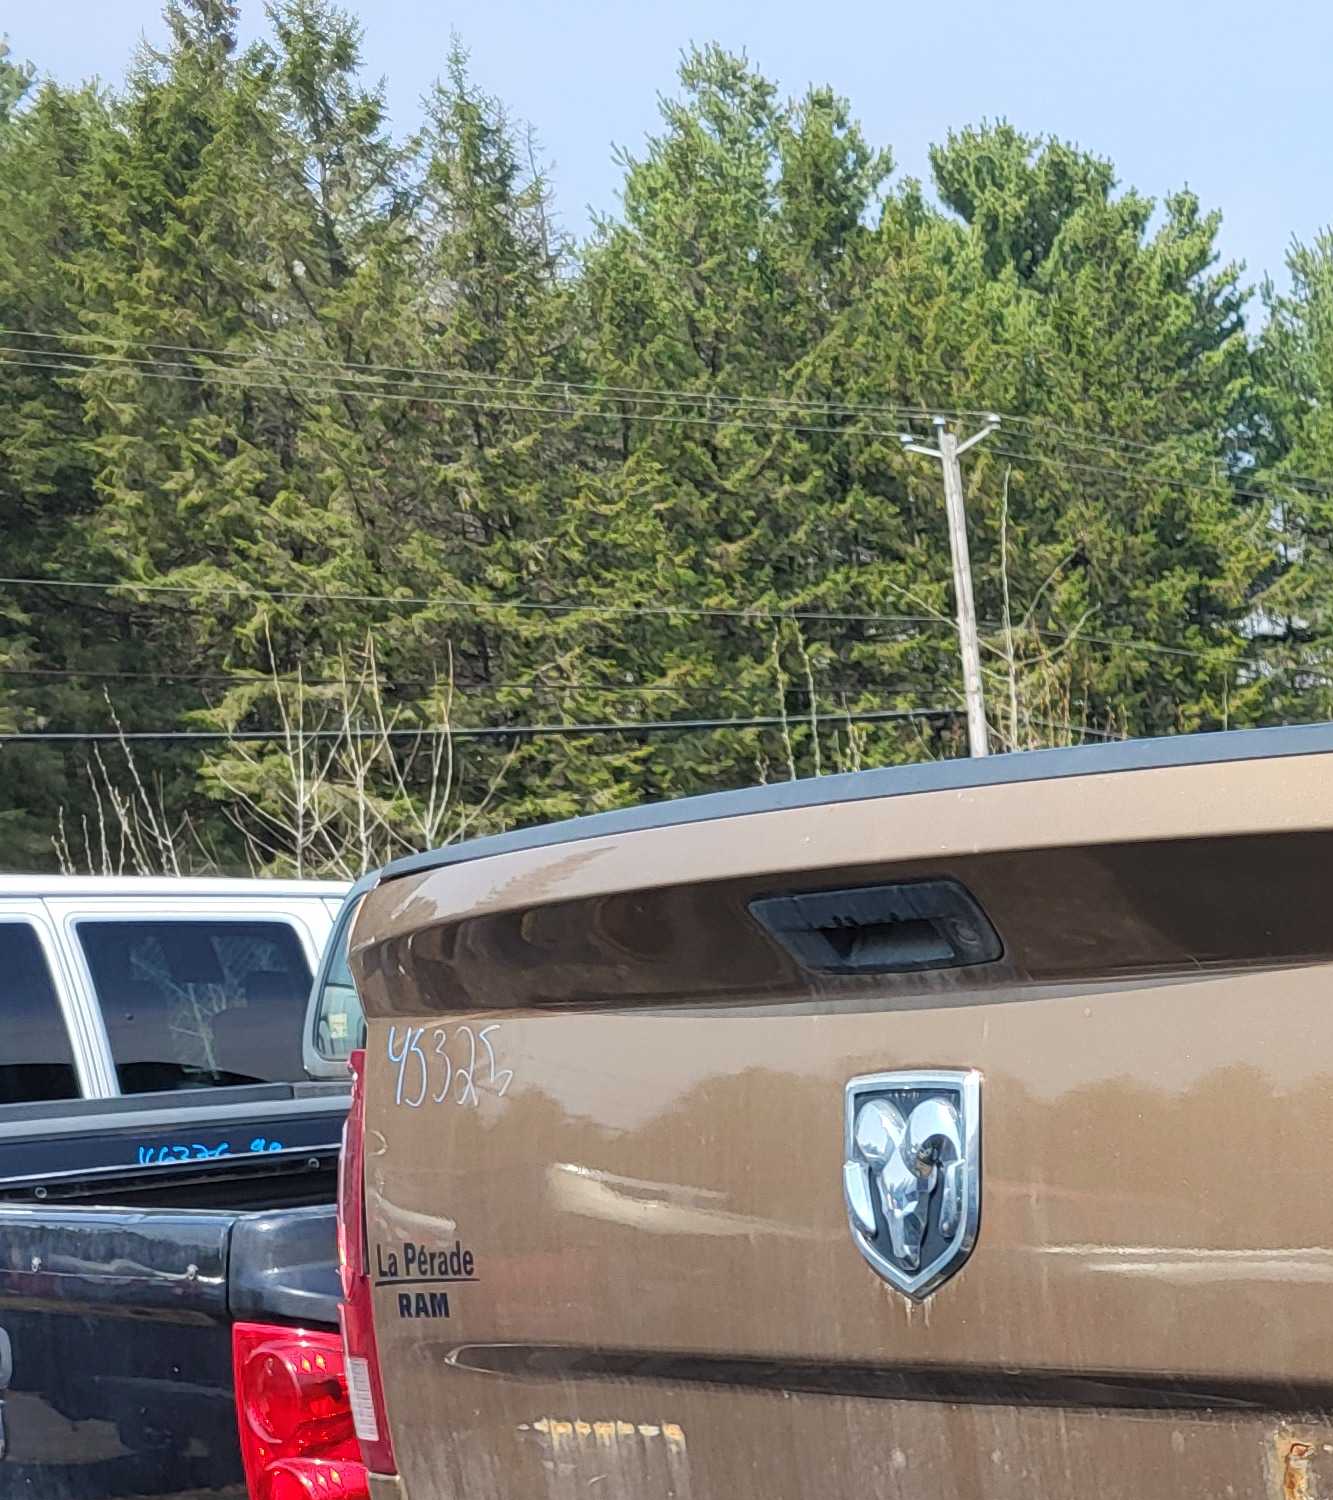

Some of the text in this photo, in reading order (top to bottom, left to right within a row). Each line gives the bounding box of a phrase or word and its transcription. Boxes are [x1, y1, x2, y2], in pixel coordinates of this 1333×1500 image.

[387, 1024, 513, 1107] 45325
[376, 1240, 475, 1277] La Pérade
[398, 1292, 450, 1318] RAM
